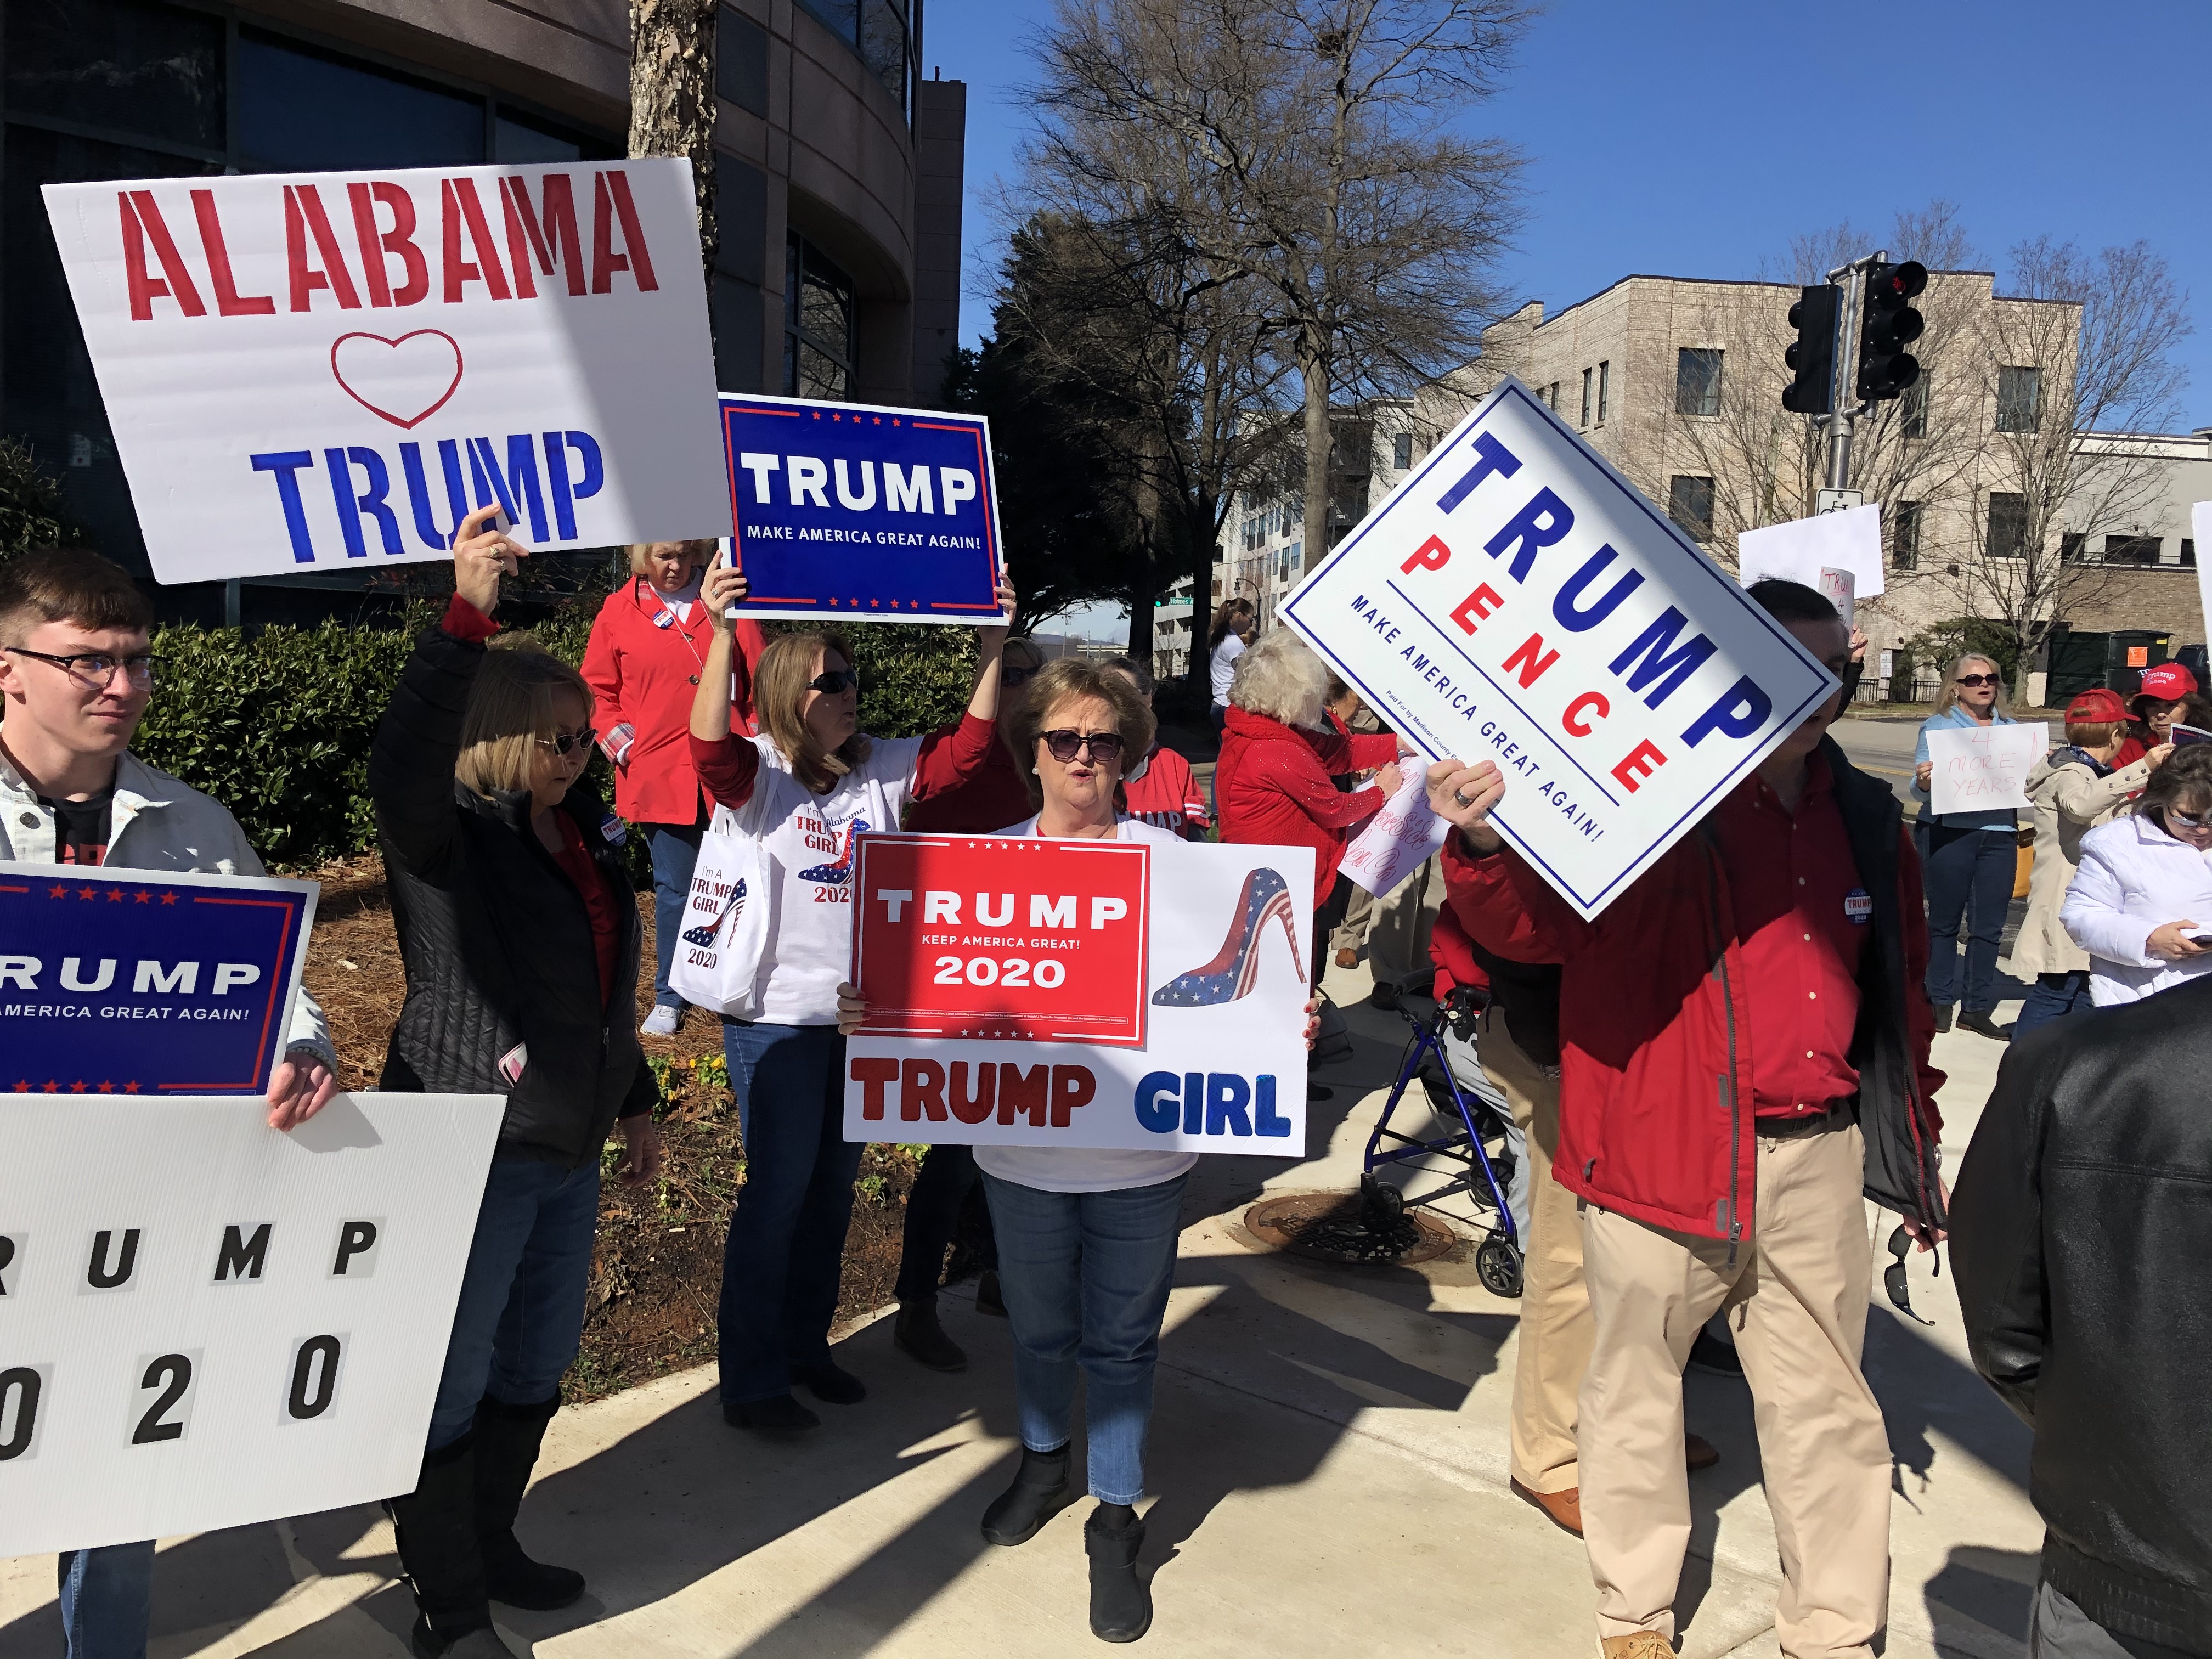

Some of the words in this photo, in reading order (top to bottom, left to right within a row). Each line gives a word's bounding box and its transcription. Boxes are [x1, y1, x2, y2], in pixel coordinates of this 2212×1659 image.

[119, 172, 658, 321] ALABAMA
[740, 452, 977, 516] TRUMP
[250, 431, 604, 563] TRUMP
[748, 525, 793, 540] MAKE
[798, 528, 872, 544] AMERICA
[876, 532, 924, 546] GREAT
[929, 535, 981, 549] AGAIN!
[1437, 431, 1772, 749] TRUMP
[654, 611, 669, 624] TRUMP
[1401, 534, 1668, 794] PENCE
[1351, 594, 1401, 644] MAKE
[1401, 646, 1477, 720] AMERICA
[1481, 721, 1541, 778] GREAT
[1538, 781, 1603, 843] AGAIN!
[1386, 690, 1398, 703] Paid
[1397, 701, 1407, 711] For
[1406, 709, 1414, 718] by
[1412, 716, 1434, 738] Madison
[1433, 736, 1452, 756] County
[1971, 730, 1997, 752] 4
[1953, 776, 2016, 798] YEARS
[602, 819, 622, 836] TRUMP
[794, 816, 843, 844] TRUP
[804, 834, 840, 856] GIRL
[702, 865, 714, 878] I'm
[714, 868, 722, 879] A
[691, 877, 732, 899] TRUMP
[814, 887, 852, 903] 202
[693, 896, 720, 915] GIRL
[877, 889, 1127, 930] TRUMP
[1847, 898, 1871, 909] TRUMP
[922, 934, 957, 945] KEEP
[962, 936, 1025, 947] AMERICA
[1030, 938, 1080, 950] GREAT!
[687, 948, 718, 969] 2020
[0, 955, 261, 995] RUMP
[933, 956, 1065, 989] 2020
[0, 1004, 92, 1018] MERICA
[100, 1006, 172, 1019] GREAT
[178, 1008, 249, 1020] AGAIN!
[851, 1058, 1096, 1127] TRUMP
[1133, 1071, 1291, 1137] GIRL
